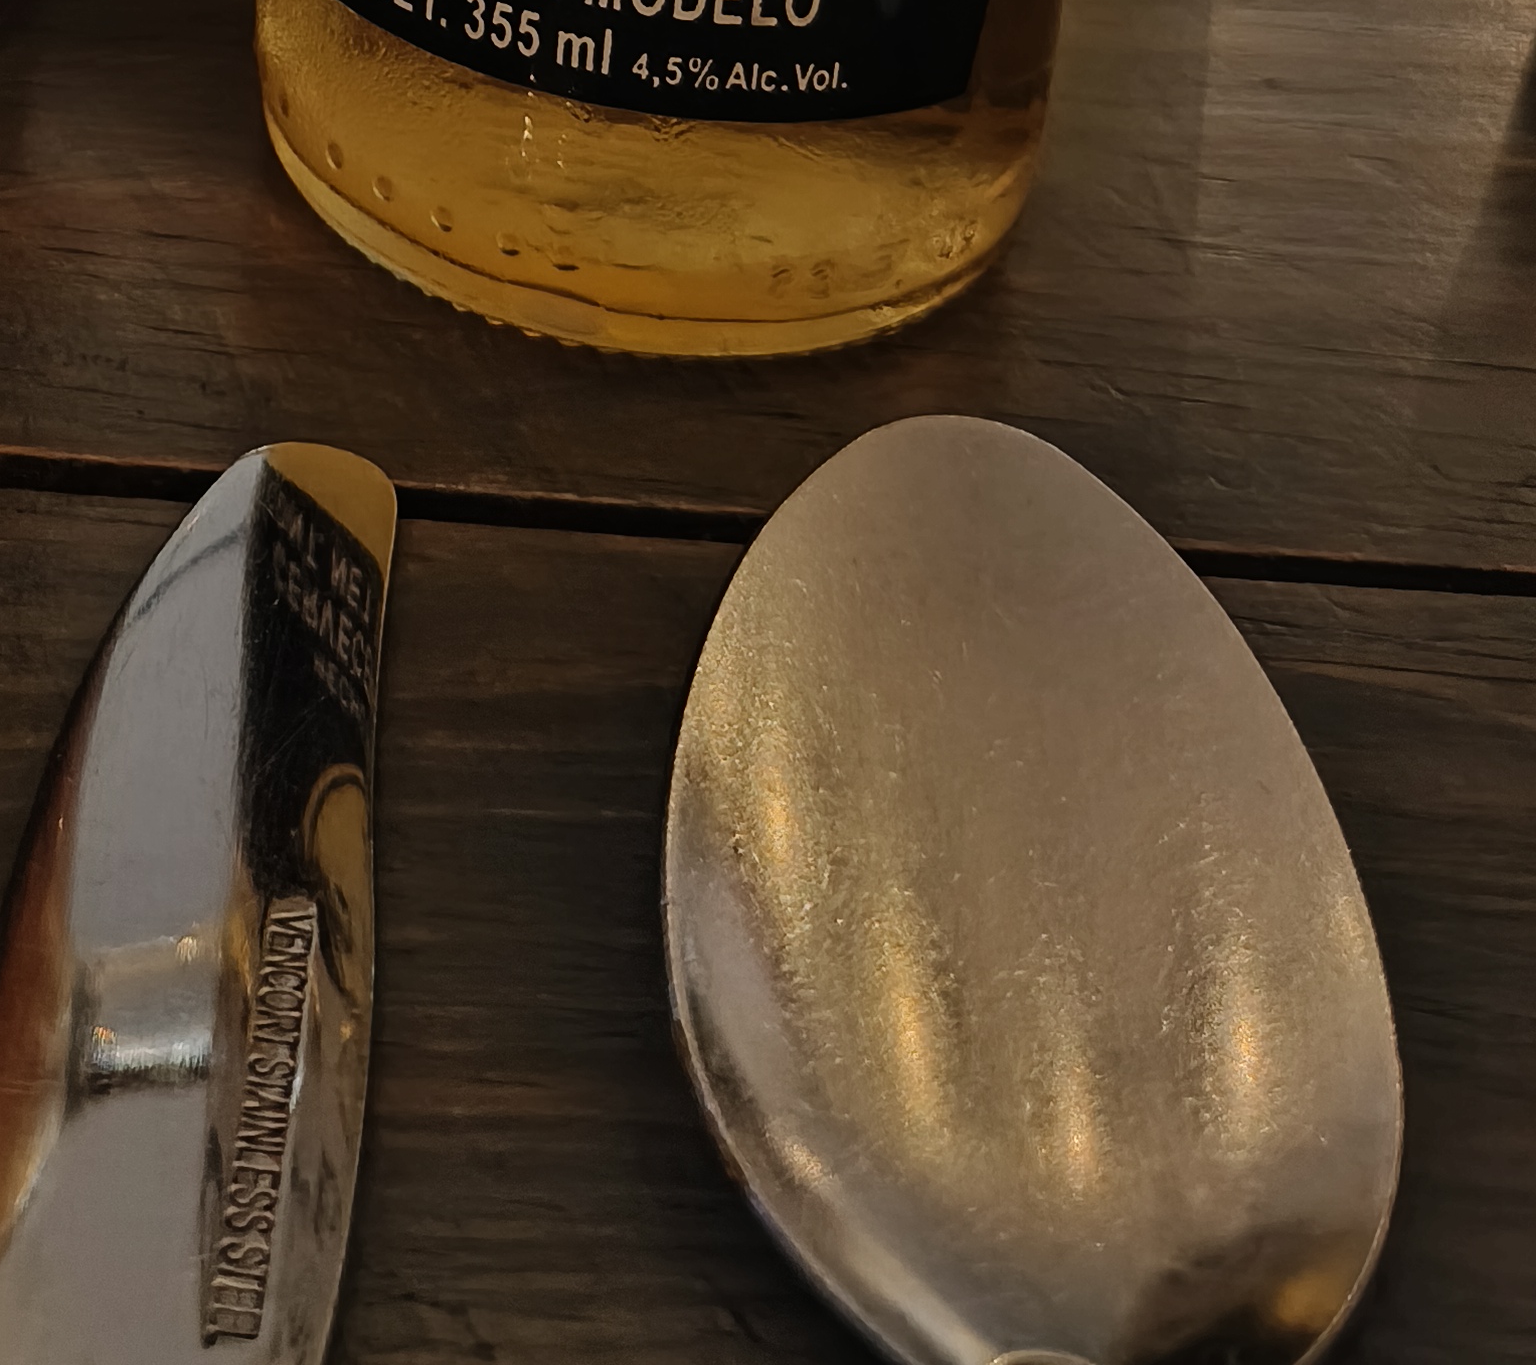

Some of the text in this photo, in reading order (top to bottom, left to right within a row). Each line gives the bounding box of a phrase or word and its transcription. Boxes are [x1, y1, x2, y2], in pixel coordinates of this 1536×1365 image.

[556, 27, 612, 75] ml
[631, 52, 719, 91] 4,5%
[203, 909, 316, 1348] VENCORT STAINLESS STEEL
